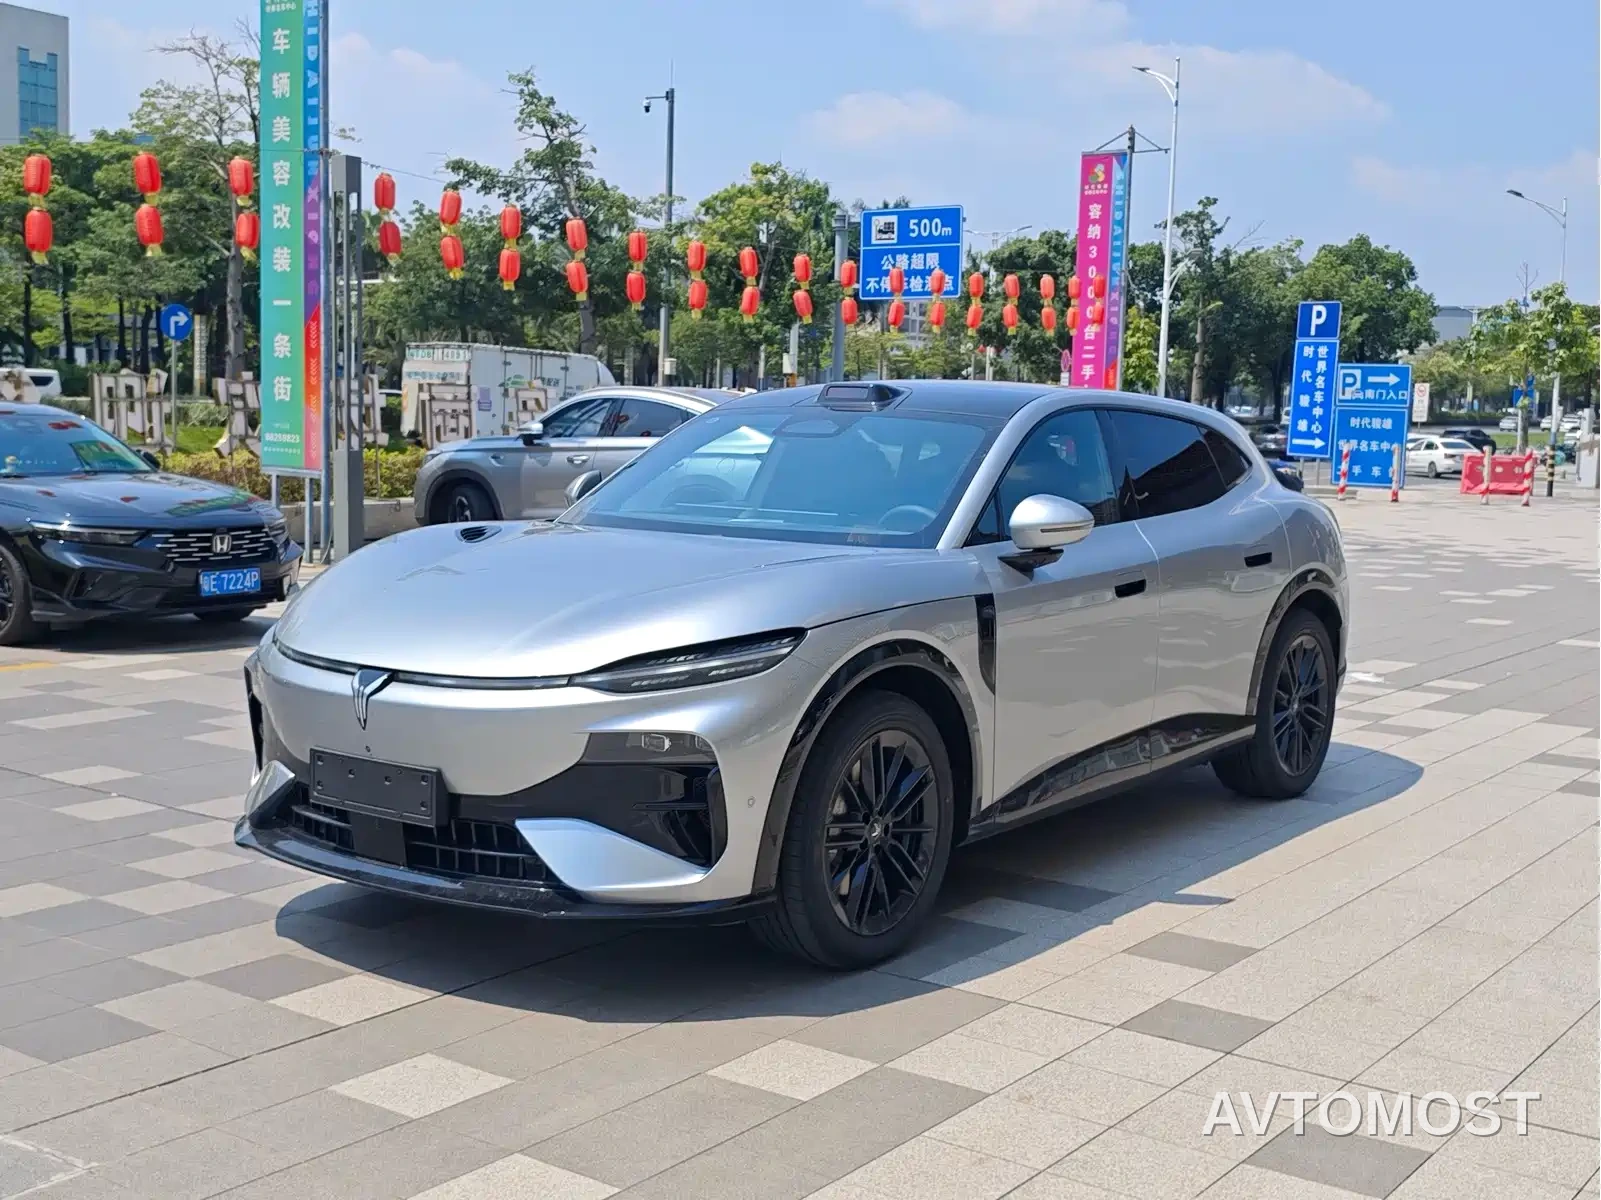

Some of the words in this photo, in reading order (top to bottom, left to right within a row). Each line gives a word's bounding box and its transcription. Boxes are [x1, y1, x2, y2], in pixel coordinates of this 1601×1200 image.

[272, 28, 292, 402] 车辆美容改装一条街
[909, 218, 952, 237] 500m
[881, 252, 940, 270] 公路超限
[1310, 304, 1327, 336] P
[1311, 345, 1329, 434] 世界名车中心
